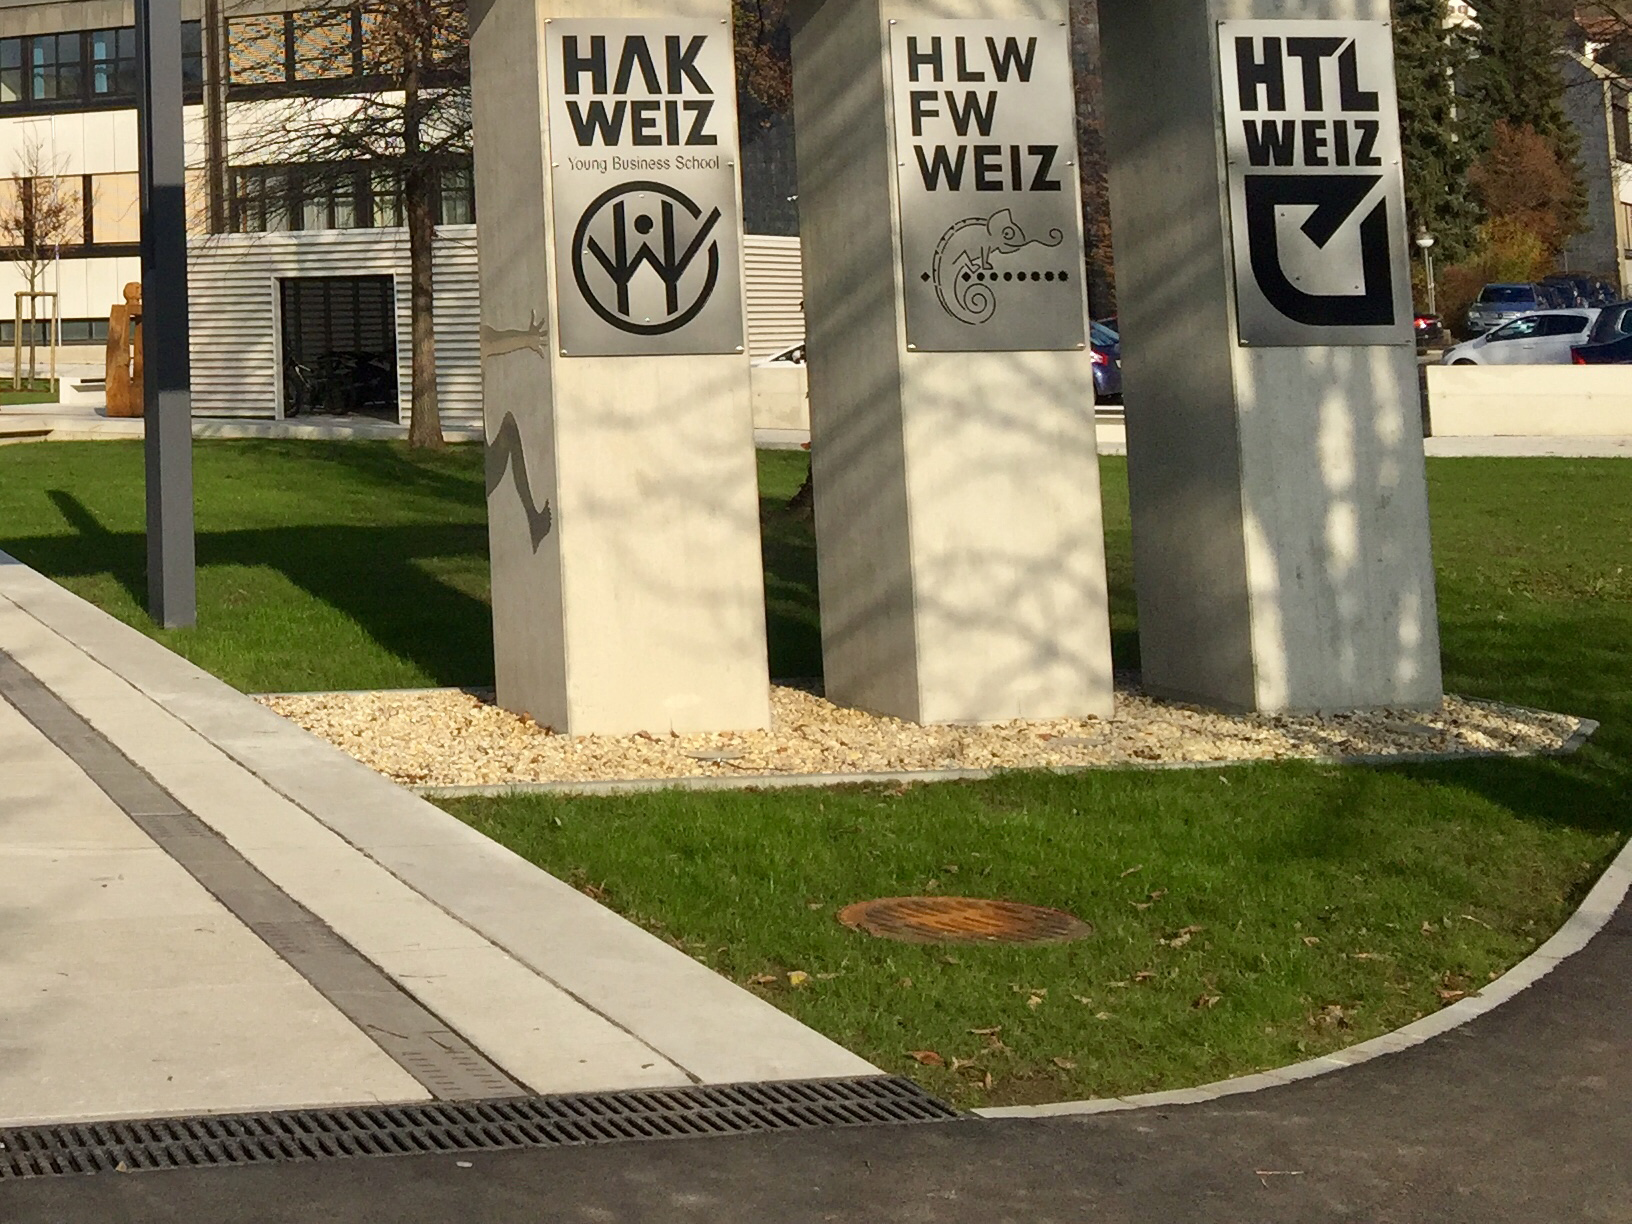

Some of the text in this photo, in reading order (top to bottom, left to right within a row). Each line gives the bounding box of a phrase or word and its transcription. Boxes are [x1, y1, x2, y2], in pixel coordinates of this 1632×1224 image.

[562, 35, 714, 95] HAK
[907, 36, 1037, 82] HLW
[1235, 36, 1379, 112] HTL
[565, 100, 718, 146] WEIZ
[910, 91, 998, 137] FW
[567, 155, 720, 174] Young Business School
[1242, 120, 1382, 166] WEIZ
[913, 145, 1062, 191] WEIZ
